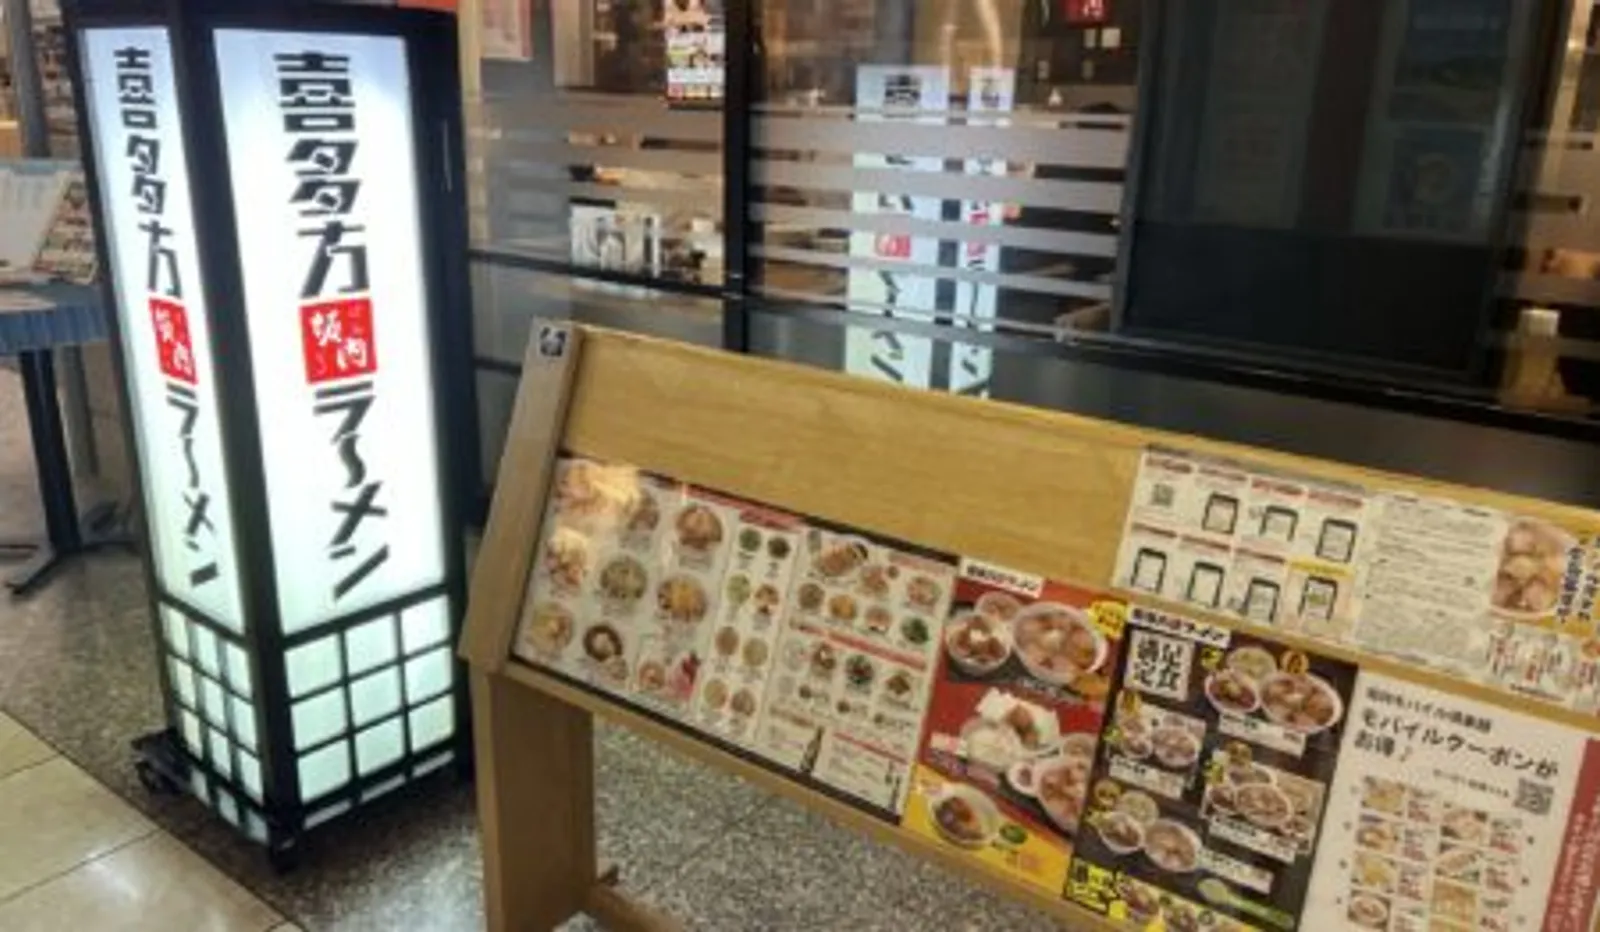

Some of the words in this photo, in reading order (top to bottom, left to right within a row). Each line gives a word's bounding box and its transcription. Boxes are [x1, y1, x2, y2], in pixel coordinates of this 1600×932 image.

[113, 46, 184, 298] 喜多方
[273, 50, 371, 299] 喜多方
[166, 381, 219, 589] ラーメン
[312, 381, 390, 602] ラーメン
[1361, 707, 1561, 780] モバイルクーポンが
